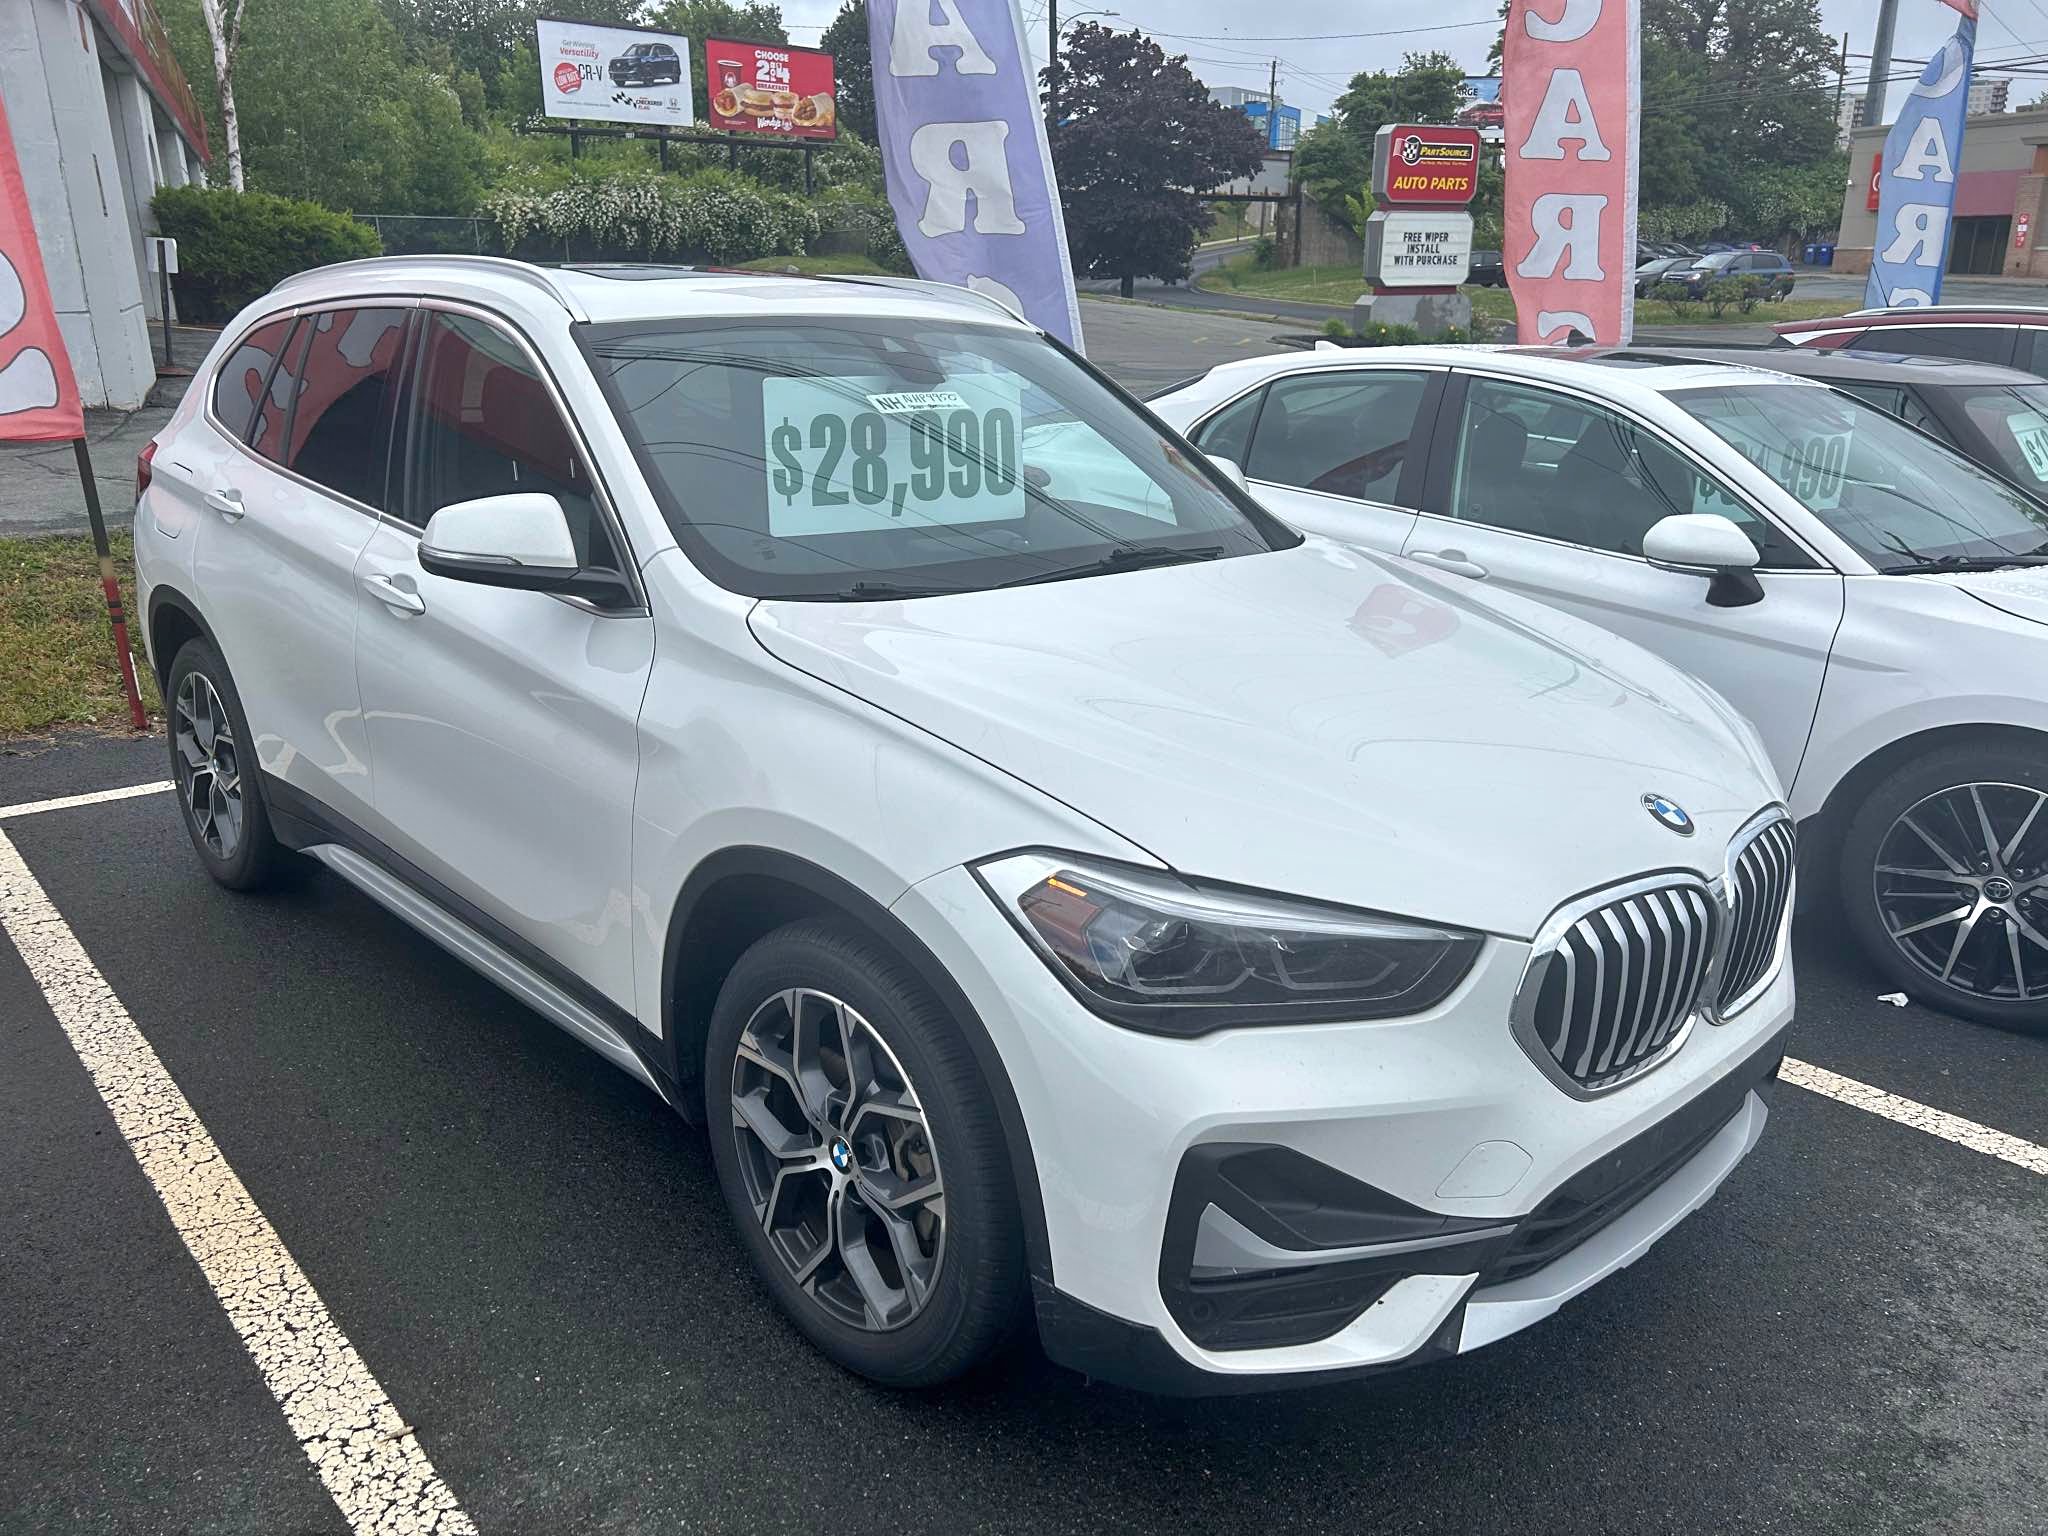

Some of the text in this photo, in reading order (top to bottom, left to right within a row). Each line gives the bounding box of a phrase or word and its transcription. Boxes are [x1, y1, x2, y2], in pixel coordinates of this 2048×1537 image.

[559, 47, 600, 60] Versatility
[755, 50, 789, 62] CHOOSE
[578, 63, 603, 81] CR-V
[756, 60, 770, 82] 2
[757, 82, 789, 92] BREAKFAST
[1392, 176, 1469, 191] AUTO PARTS
[1403, 231, 1449, 242] FREE WIPER
[1407, 243, 1440, 254] INSTALL
[1394, 255, 1458, 265] WITH PURCHASE
[875, 396, 906, 410] NH
[771, 408, 1016, 517] $28,990
